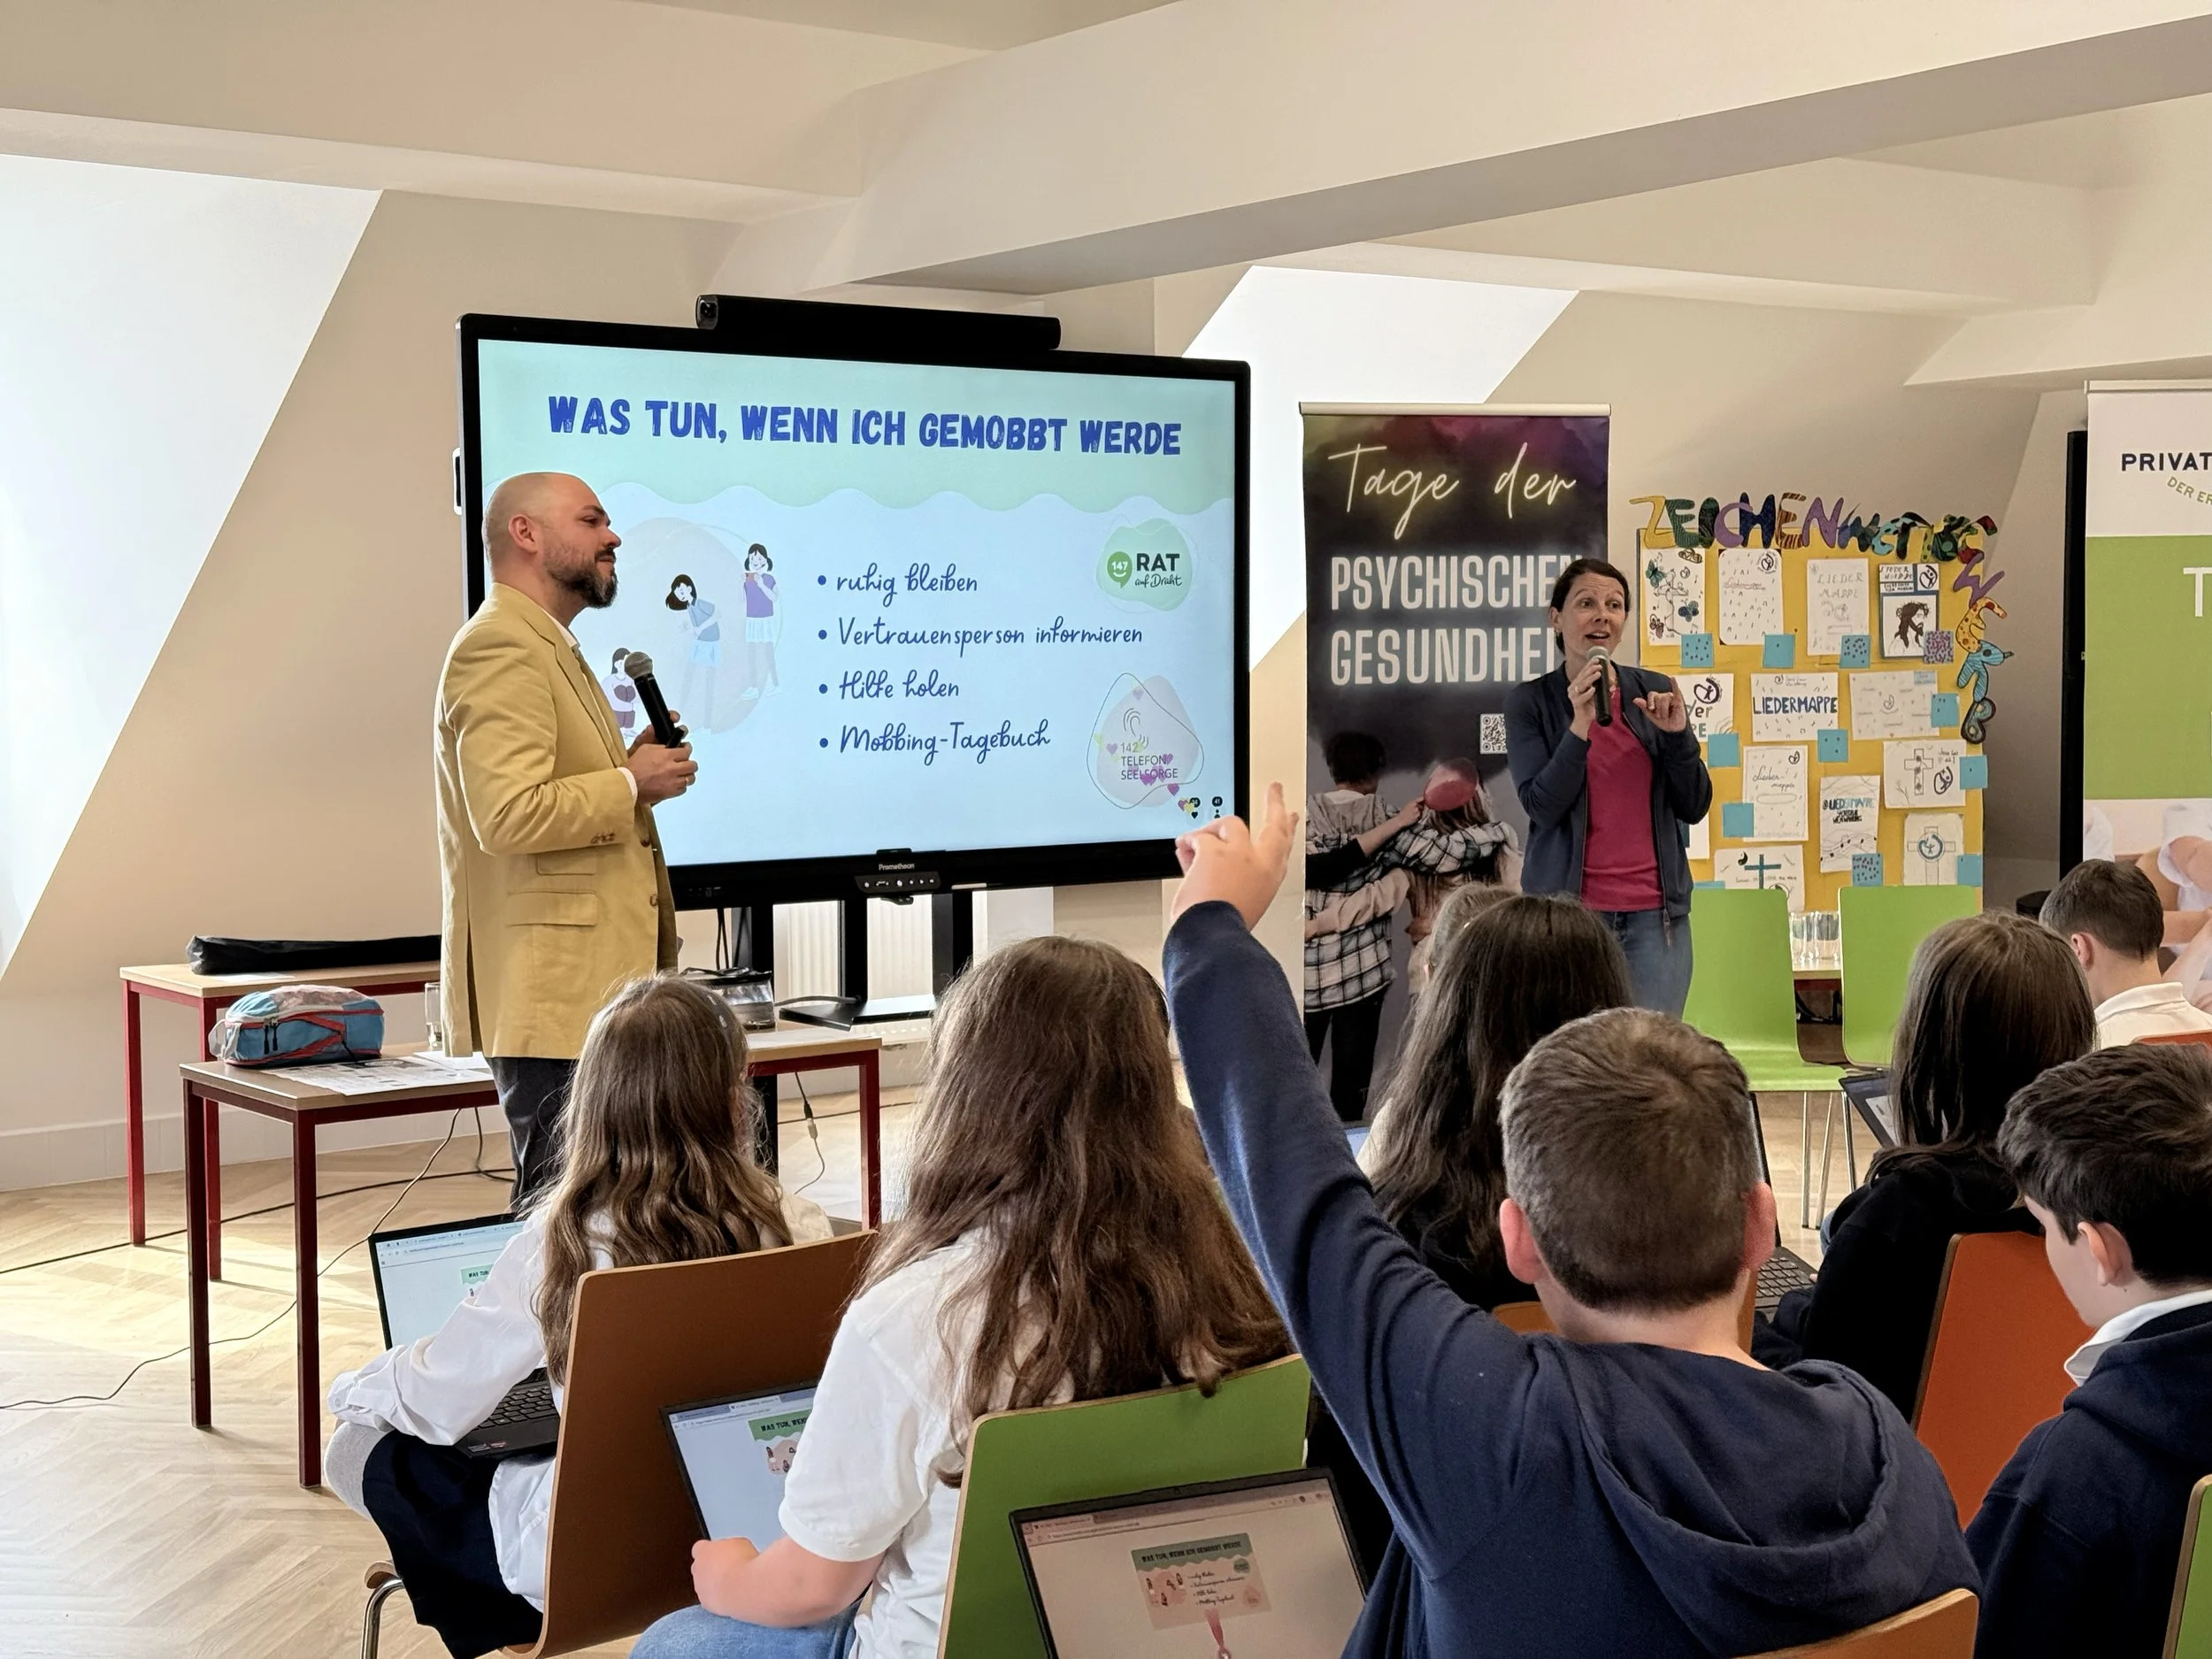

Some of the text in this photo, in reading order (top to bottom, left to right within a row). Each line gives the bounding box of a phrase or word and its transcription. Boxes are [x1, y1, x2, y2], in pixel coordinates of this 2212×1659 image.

[549, 396, 1181, 456] WAS TUN, WENN ICH GEMOBBT WERDE
[2121, 452, 2212, 472] PRIVAT
[1328, 442, 1577, 541] Tage der
[2167, 476, 2194, 498] DER
[1111, 560, 1128, 571] 147
[1136, 552, 1180, 572] RAT
[837, 562, 978, 608] ruhig bleiben
[1135, 573, 1182, 588] auf Draht
[839, 615, 1143, 658] Vertrauensperson informieren
[1331, 627, 1555, 686] GESUNDHEI
[839, 669, 959, 700] Hilfe holen
[1753, 695, 1838, 715] LIEDERMAPPE
[840, 718, 1051, 766] Mobbing-Tagebuch
[1121, 742, 1139, 753] 142
[1121, 755, 1167, 767] TELEFON
[1121, 768, 1179, 780] SEELSORGE
[761, 1423, 775, 1432] WAS
